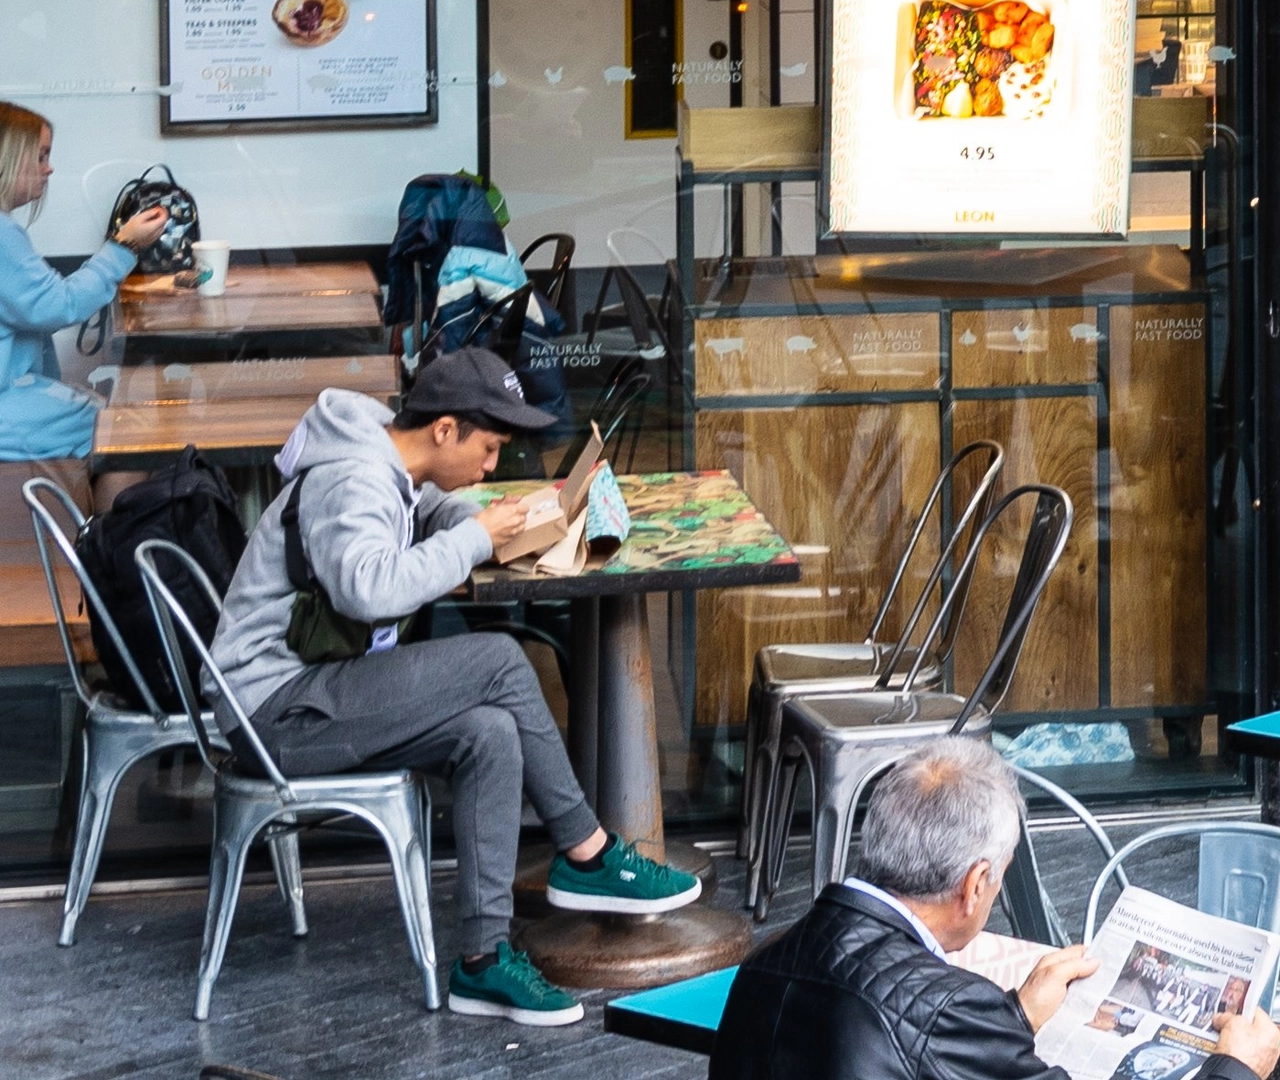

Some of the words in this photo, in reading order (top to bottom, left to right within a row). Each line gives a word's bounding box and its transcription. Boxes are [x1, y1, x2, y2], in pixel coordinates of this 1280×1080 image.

[201, 65, 272, 80] GOLDEN
[671, 59, 743, 73] NATURALLY
[671, 72, 700, 85] FAST
[704, 71, 742, 84] FOOD
[959, 145, 996, 161] 4.95
[954, 209, 995, 224] LEON
[1134, 317, 1204, 331] NATURALLY
[853, 328, 924, 342] NATURALLY
[1134, 330, 1163, 342] FAST
[1167, 328, 1203, 341] FOOD
[529, 343, 602, 357] NATURALLY
[885, 340, 922, 352] FOOD
[529, 355, 559, 369] FAST
[563, 355, 600, 368] FOOD
